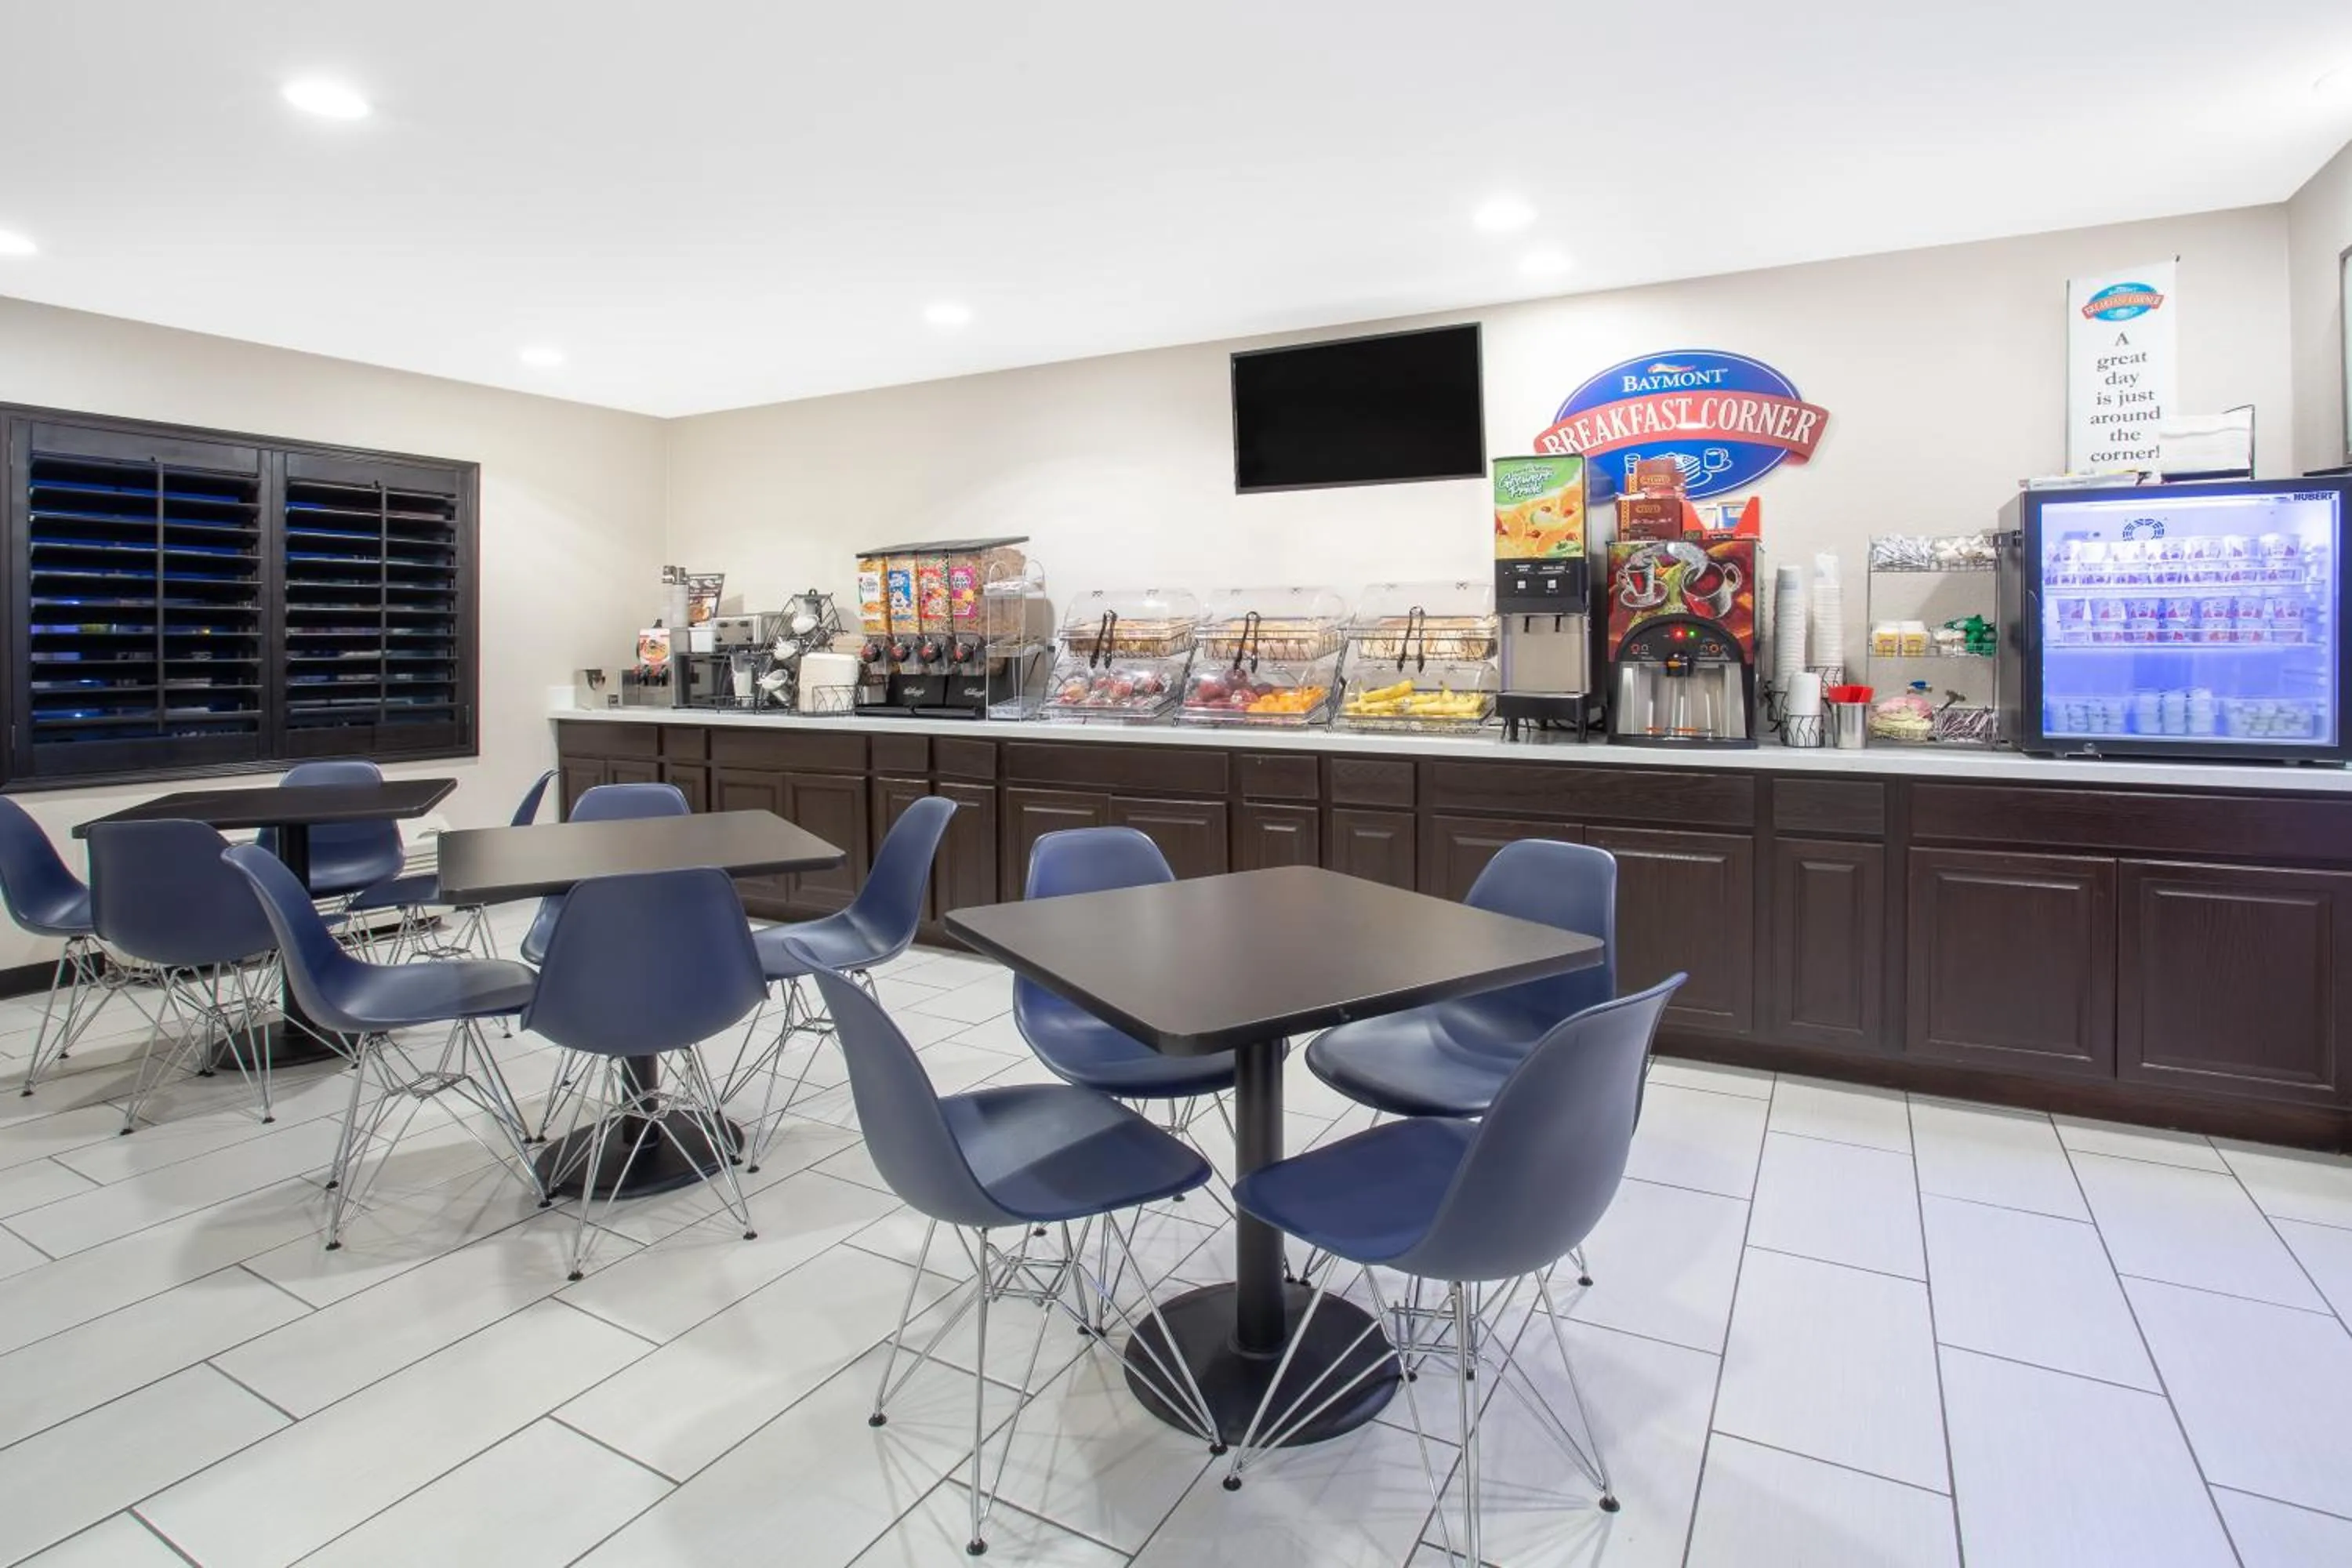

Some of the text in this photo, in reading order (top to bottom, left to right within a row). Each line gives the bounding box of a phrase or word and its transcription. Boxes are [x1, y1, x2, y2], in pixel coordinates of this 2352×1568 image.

[2114, 332, 2129, 347] A
[2096, 352, 2147, 372] great
[2105, 372, 2140, 388] day
[2096, 390, 2155, 407] is just
[2089, 406, 2161, 425] around
[1543, 397, 1820, 455] BREAKFAST CORNER
[2109, 429, 2142, 441] the
[2090, 445, 2161, 463] corner!
[2294, 492, 2334, 501] HUBERT
